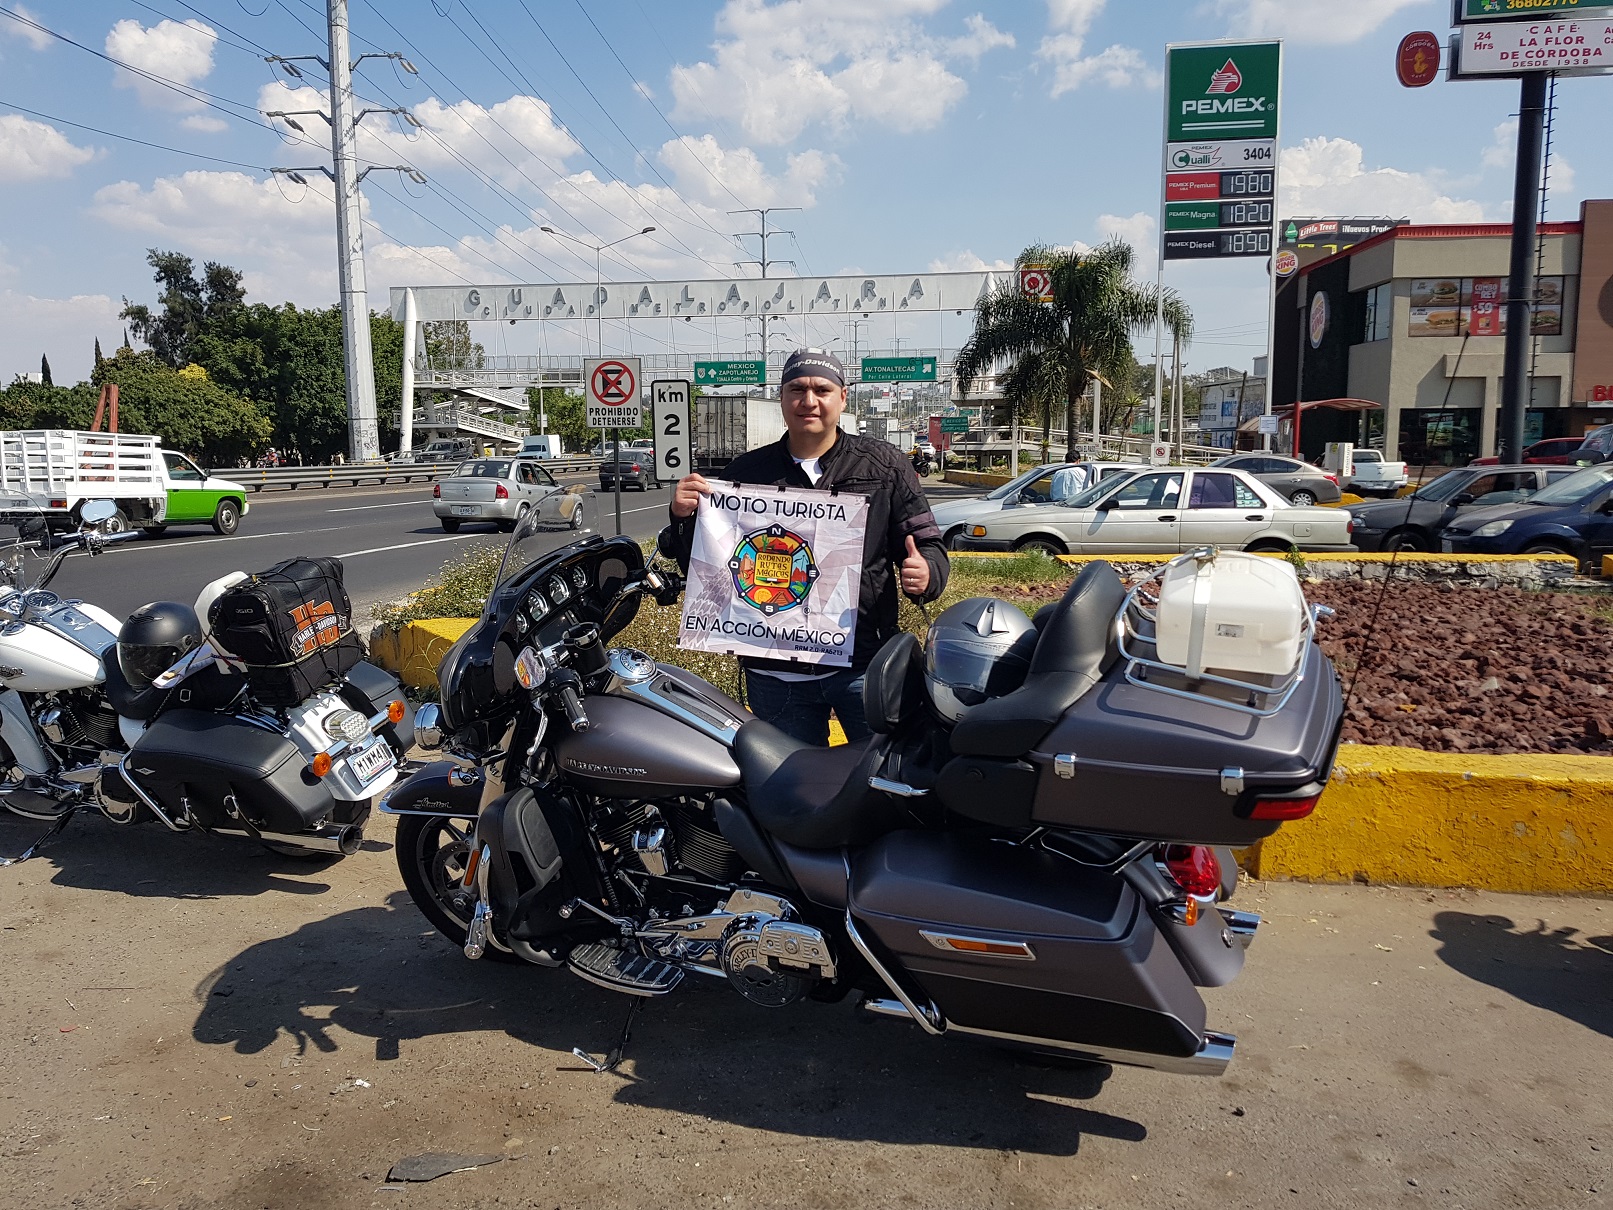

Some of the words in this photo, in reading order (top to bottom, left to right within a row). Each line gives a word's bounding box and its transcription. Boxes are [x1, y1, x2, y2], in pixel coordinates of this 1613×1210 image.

[1477, 32, 1492, 40] 24
[1519, 38, 1537, 46] LA
[1545, 36, 1585, 45] FLOR
[1474, 42, 1494, 50] Hrs
[1500, 51, 1520, 60] DE
[1525, 48, 1602, 59] CÓRDOBA
[1182, 97, 1266, 114] PEMEX
[1243, 147, 1271, 160] 3404
[1189, 181, 1216, 189] Premium
[1190, 211, 1216, 219] Magna
[1300, 225, 1317, 237] Little
[1320, 223, 1336, 231] Trees
[1189, 241, 1215, 249] Diesel
[465, 277, 924, 307] GUADALAJARA
[484, 302, 594, 316] CIUDAD
[631, 296, 909, 313] METROPOLITANA
[657, 388, 684, 403] km
[589, 407, 639, 417] PROHIBIDO
[592, 417, 636, 426] DETENERSE
[664, 414, 681, 435] 2
[664, 447, 681, 468] 6
[710, 493, 767, 514] MOTO
[773, 500, 847, 521] TURISTA
[771, 527, 782, 535] N
[765, 605, 774, 613] S
[297, 614, 338, 644] HARLE-DAVIDSON
[685, 615, 708, 631] EN
[710, 618, 777, 640] ACCIÓN
[781, 626, 846, 646] MÉXICO
